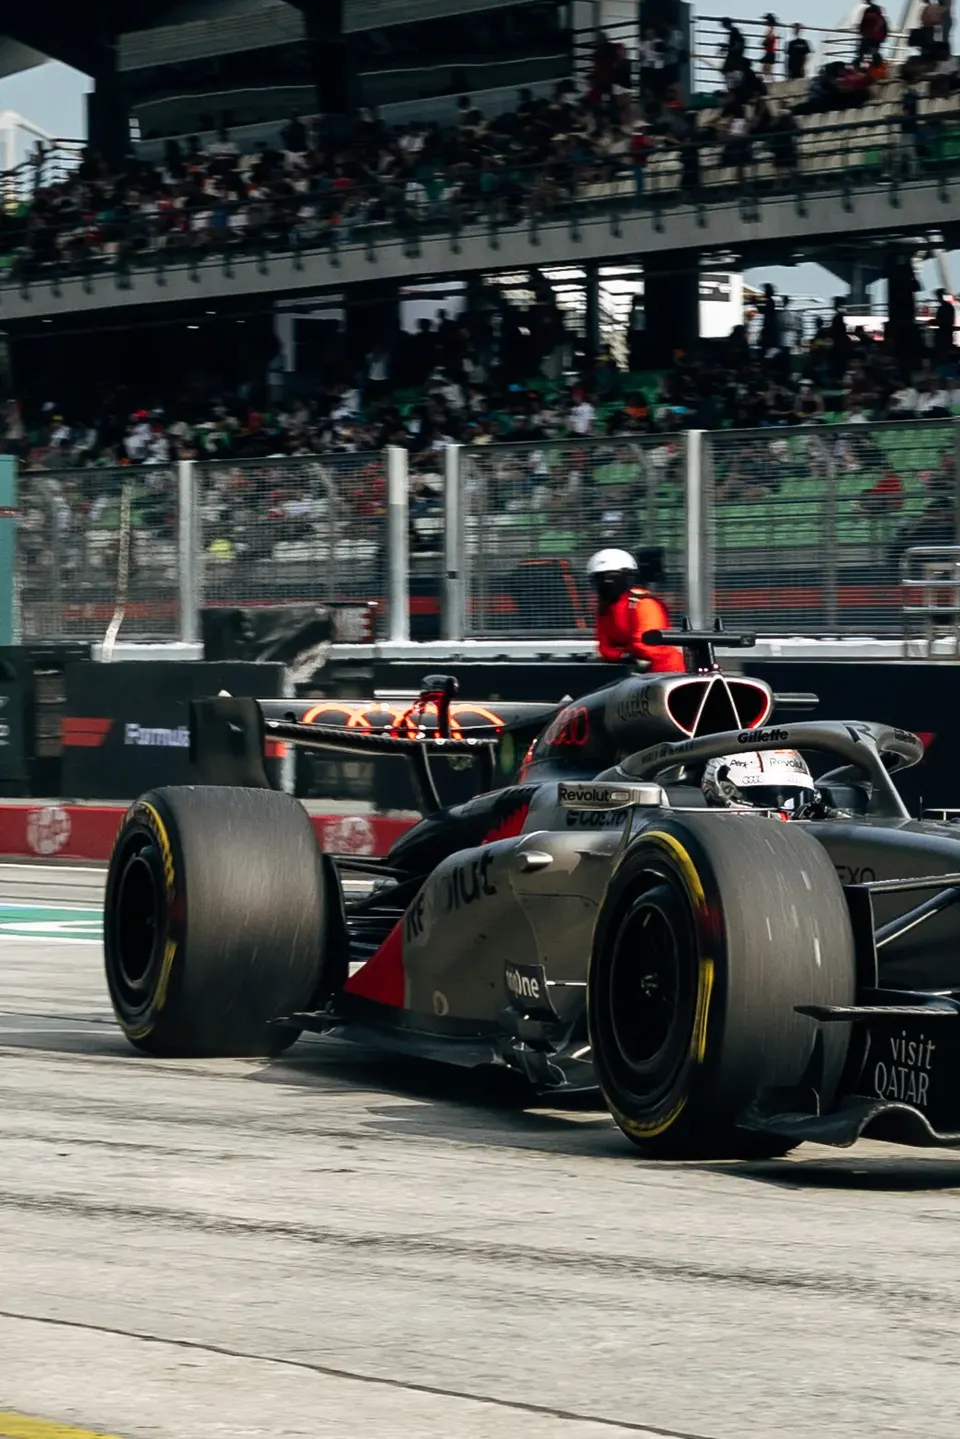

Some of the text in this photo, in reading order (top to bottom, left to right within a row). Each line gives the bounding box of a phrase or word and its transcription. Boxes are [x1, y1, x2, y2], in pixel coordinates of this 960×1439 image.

[737, 729, 789, 744] Gillette
[558, 787, 609, 802] Revolut
[834, 865, 876, 886] EXO
[890, 1029, 937, 1071] visit
[874, 1061, 930, 1107] QATAR
